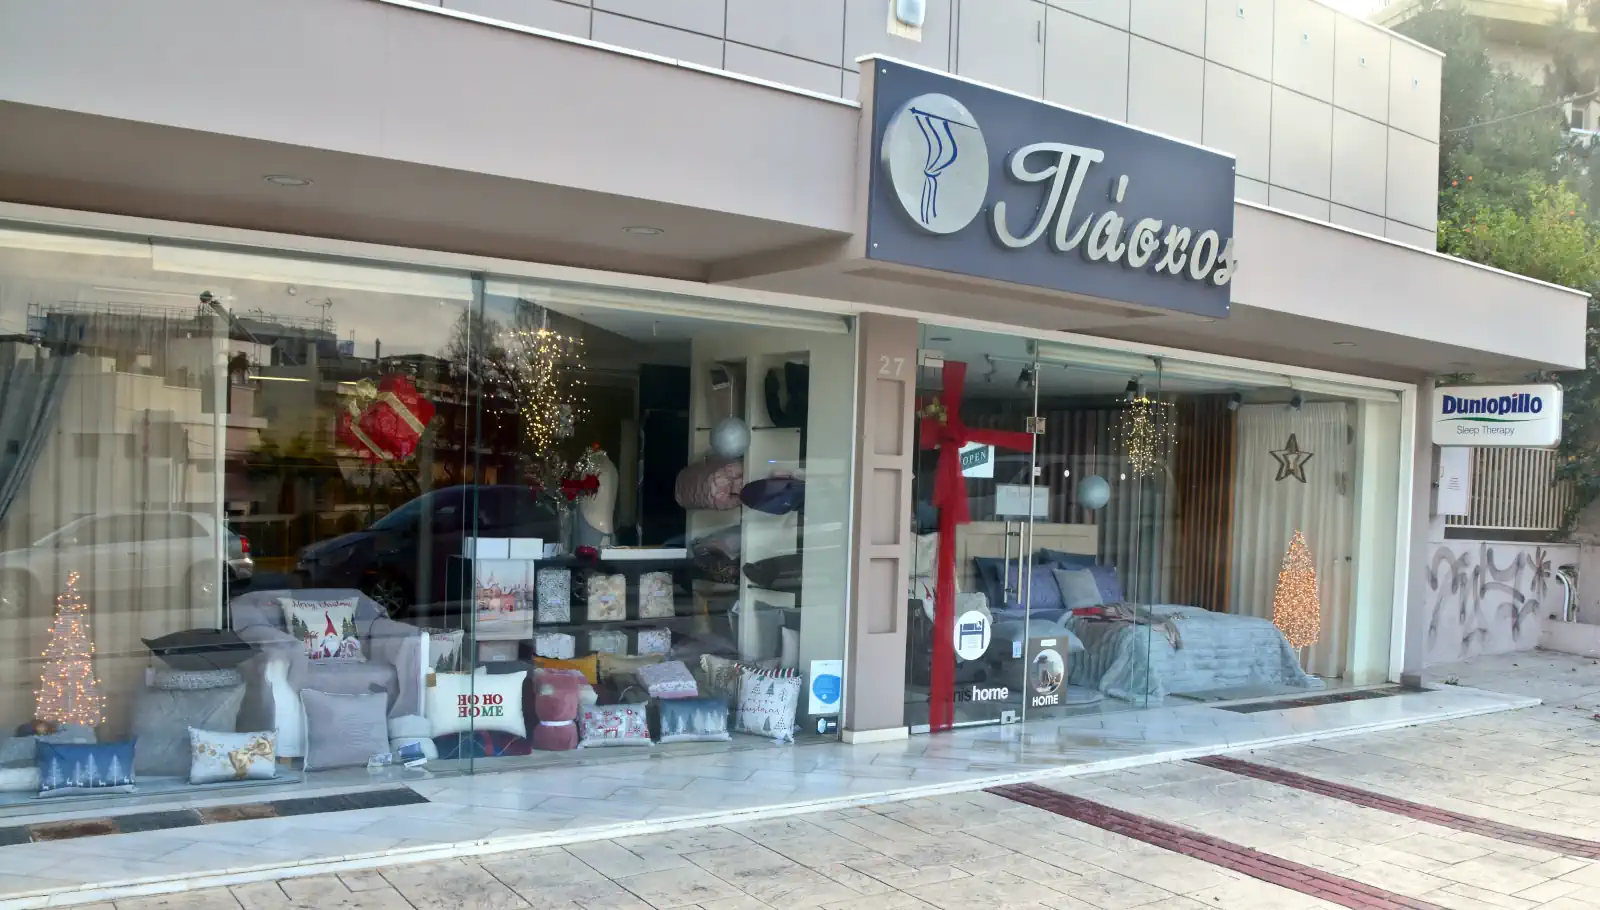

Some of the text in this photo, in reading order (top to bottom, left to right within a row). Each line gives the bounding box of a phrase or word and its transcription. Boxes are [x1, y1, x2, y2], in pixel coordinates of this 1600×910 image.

[992, 142, 1239, 286] Πάσχος
[879, 354, 905, 377] 27
[1442, 393, 1543, 415] Dunlopillo
[1456, 425, 1515, 436] Sleep Therapy
[962, 451, 987, 466] OPEN
[457, 693, 504, 706] HO HO
[953, 685, 1009, 702] nishome
[457, 705, 504, 718] HOME
